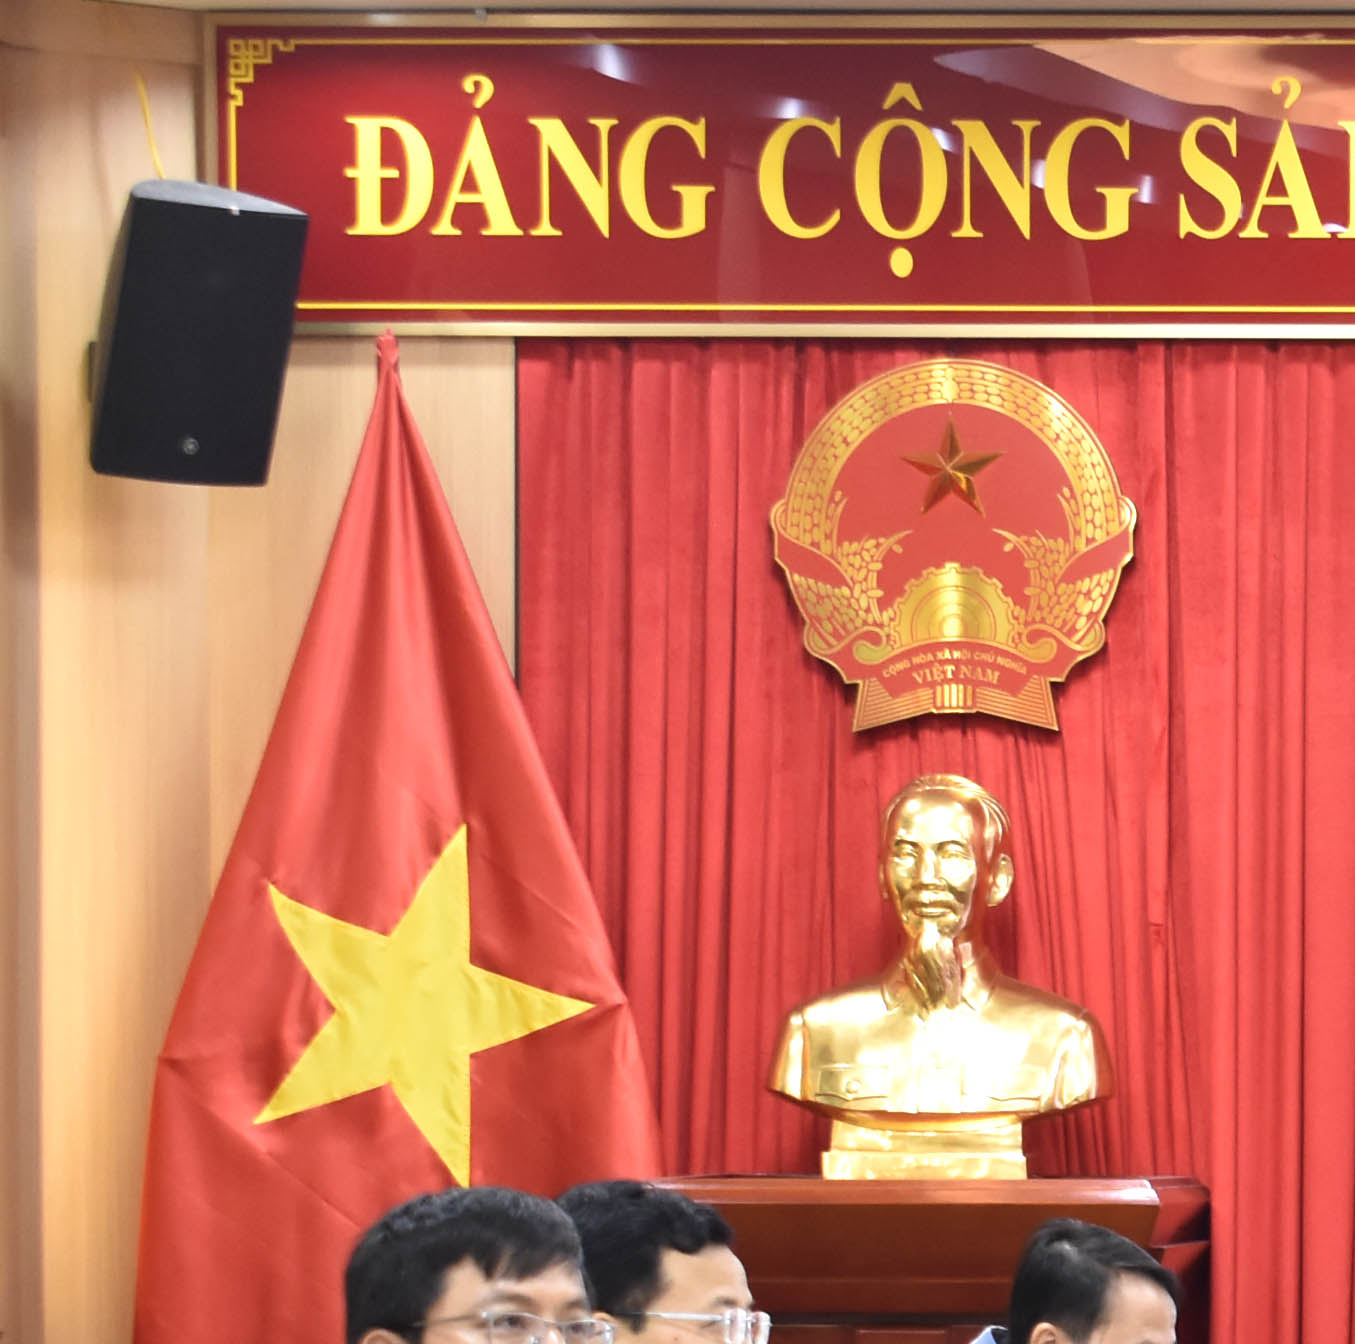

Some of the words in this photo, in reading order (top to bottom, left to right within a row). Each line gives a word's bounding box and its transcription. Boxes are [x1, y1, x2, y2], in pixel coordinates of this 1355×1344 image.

[344, 74, 716, 240] ĐẢNG
[757, 83, 1140, 278] CỘNG
[911, 662, 956, 684] VIỆT
[959, 664, 1001, 684] NAM
